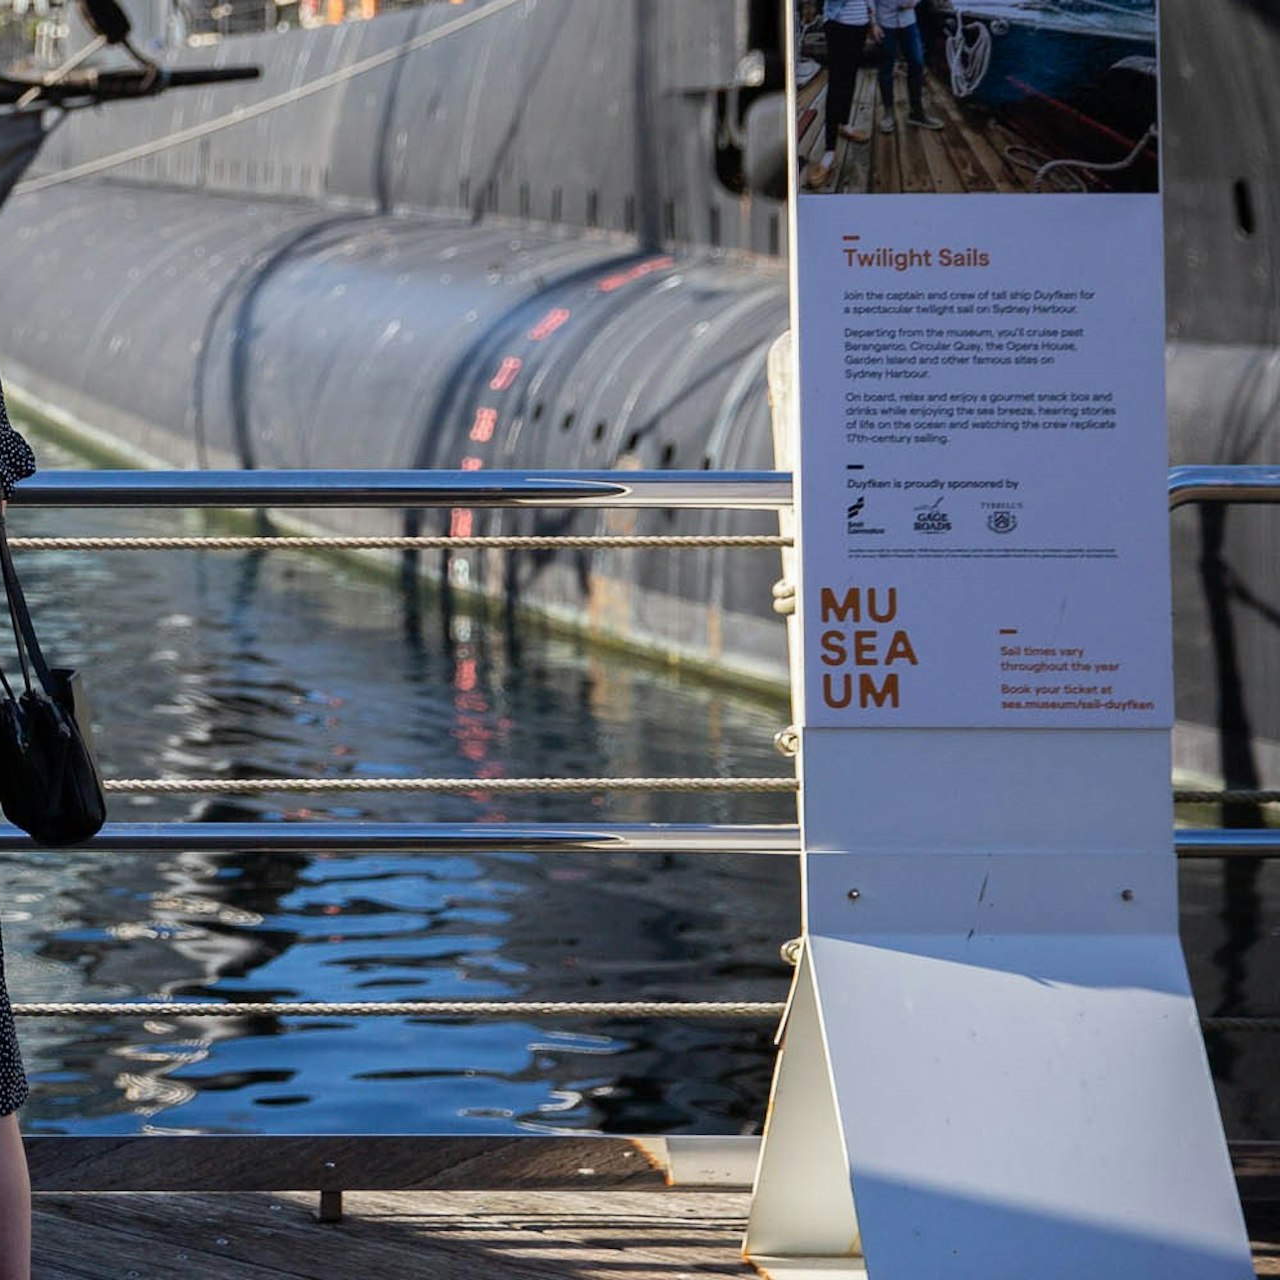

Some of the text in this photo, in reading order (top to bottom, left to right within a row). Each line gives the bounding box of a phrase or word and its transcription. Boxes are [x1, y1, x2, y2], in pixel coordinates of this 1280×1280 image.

[843, 248, 990, 271] Twilight Sails
[821, 588, 896, 623] MU
[821, 630, 918, 666] SEA
[823, 674, 899, 708] UM
